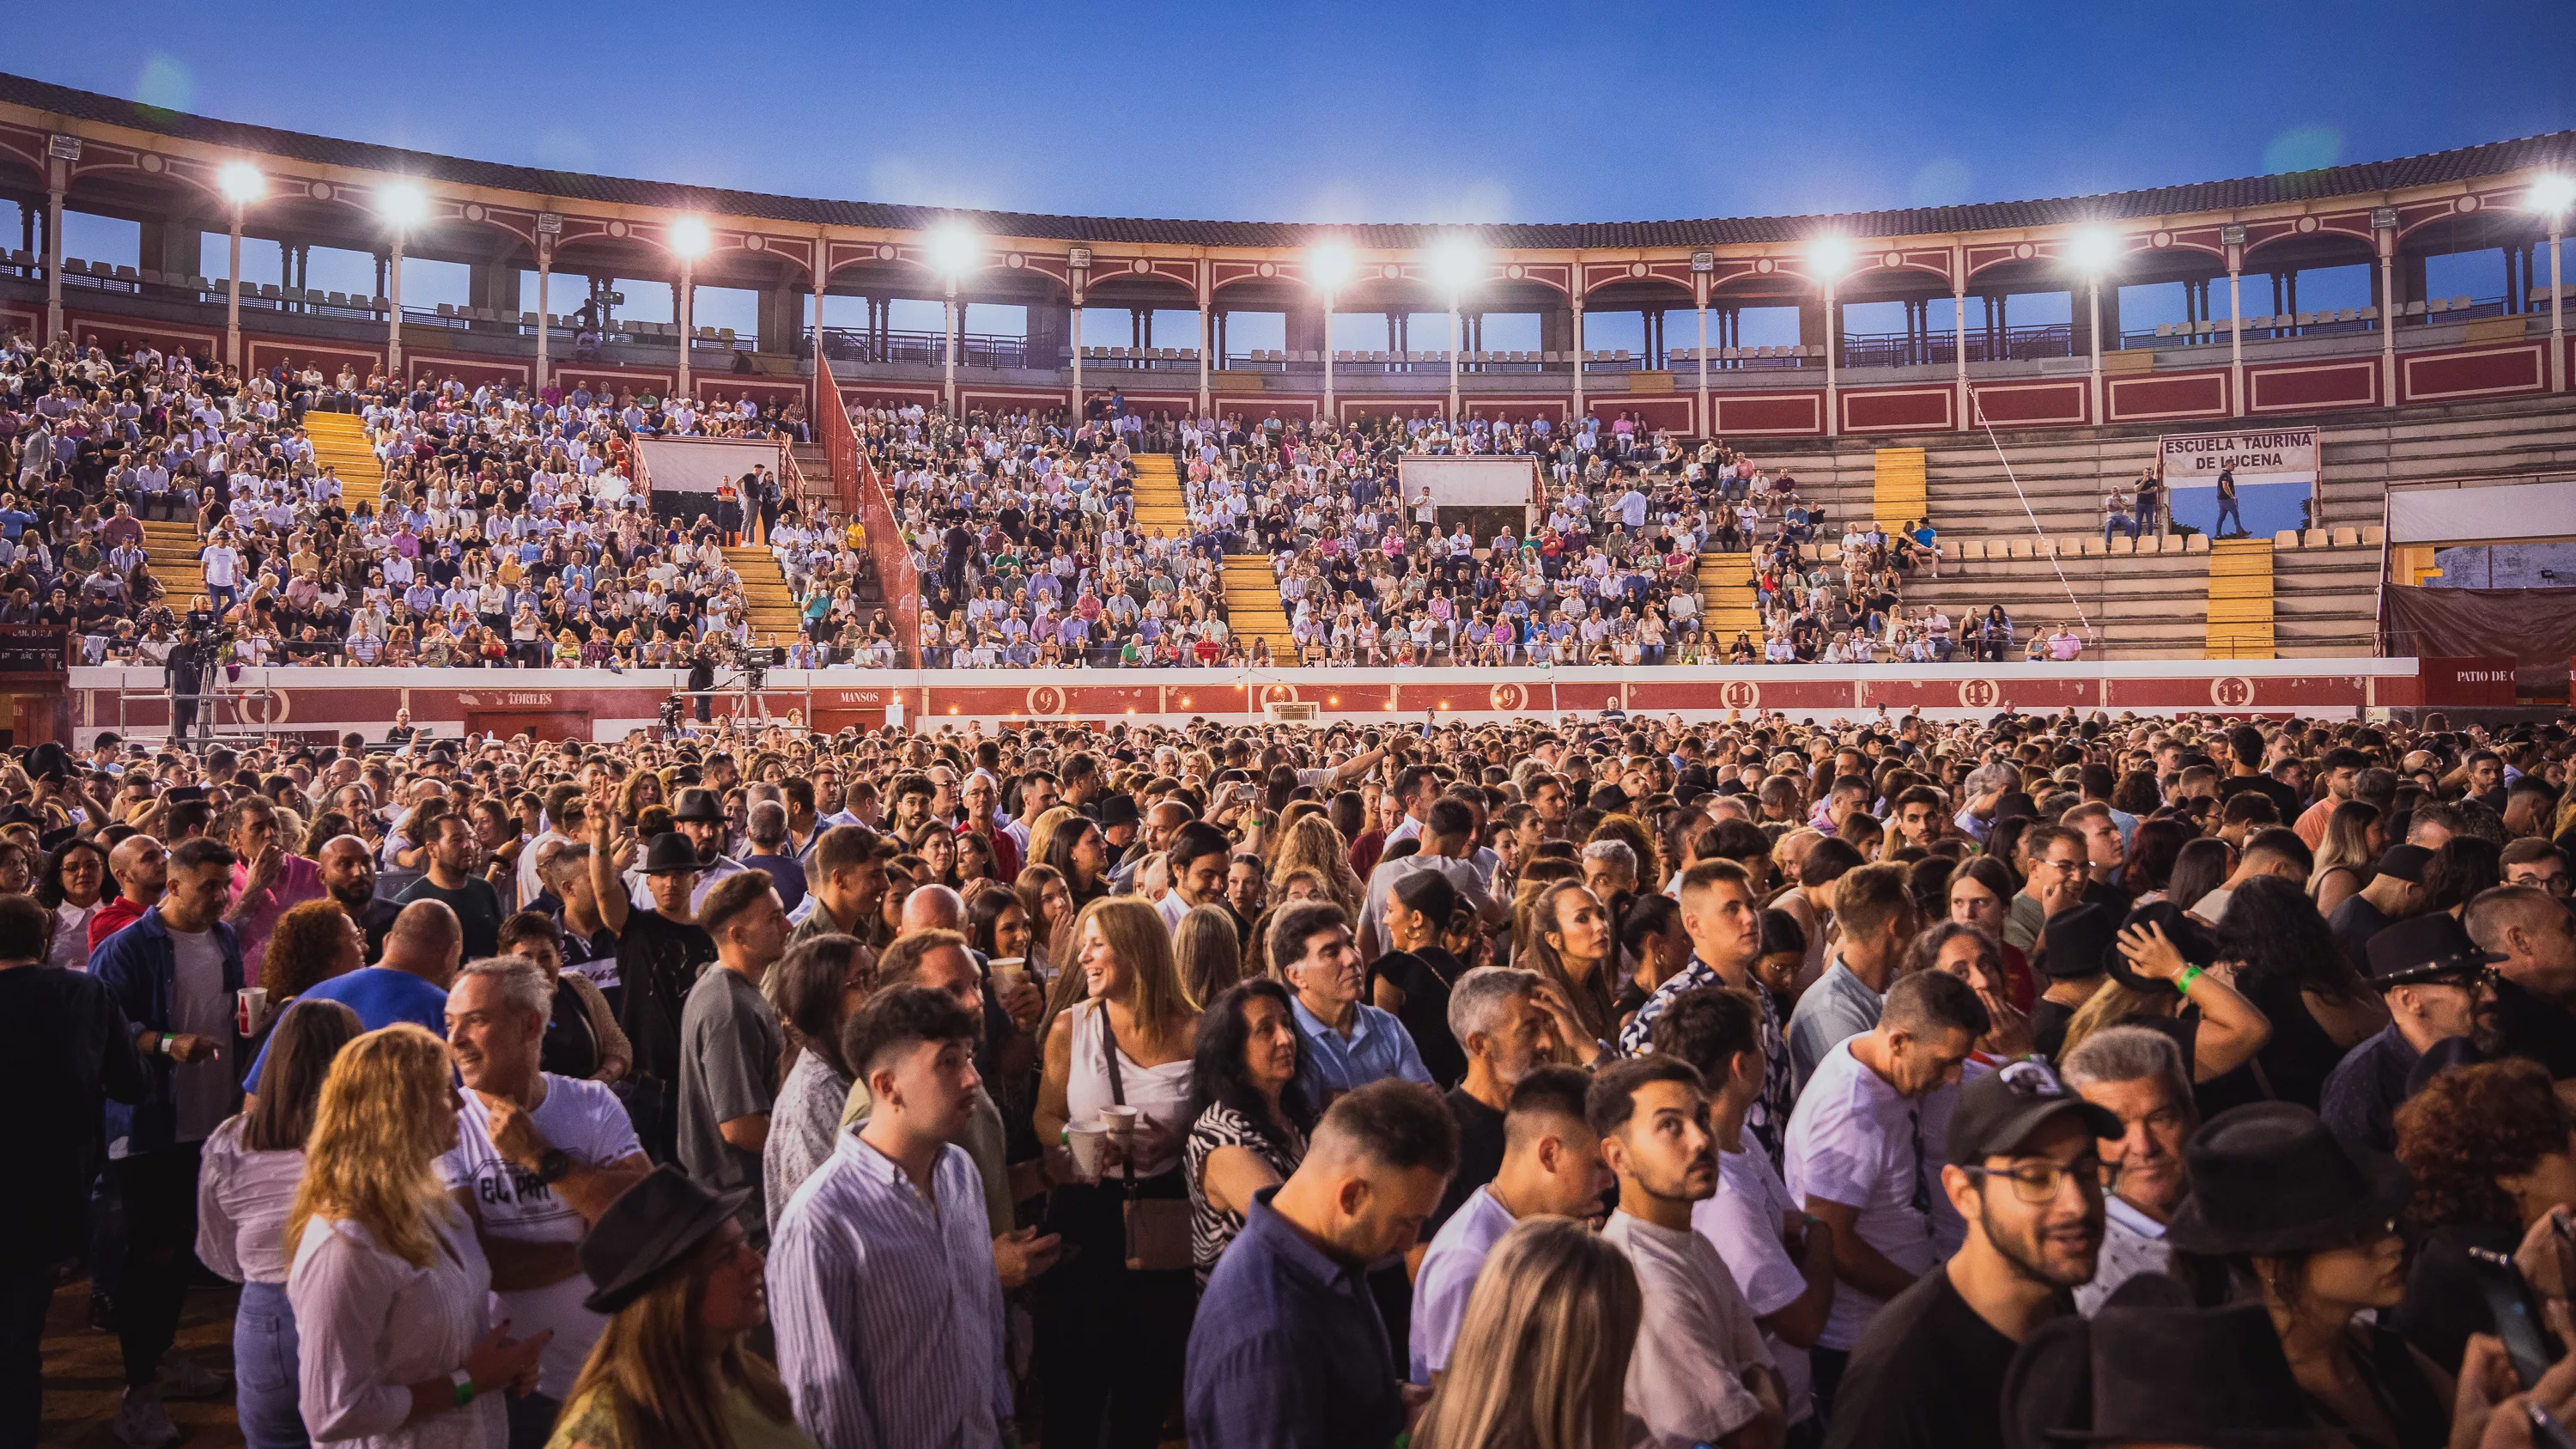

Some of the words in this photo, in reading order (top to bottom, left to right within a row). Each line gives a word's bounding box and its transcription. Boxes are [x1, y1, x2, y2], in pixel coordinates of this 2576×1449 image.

[2166, 438, 2234, 454] ESCUELA
[2243, 433, 2312, 449] TAURINA
[2196, 457, 2215, 470] DE
[2221, 453, 2283, 469] LUCENA
[2457, 671, 2488, 682] PATIO
[2492, 670, 2507, 681] DE
[507, 692, 552, 705] TORILES
[840, 692, 879, 703] MANSOS
[1040, 691, 1053, 711] 9
[1503, 686, 1516, 707] 9
[1728, 685, 1751, 704] 11
[1965, 684, 1990, 703] 11
[2219, 682, 2245, 703] 11
[481, 1176, 511, 1203] EL
